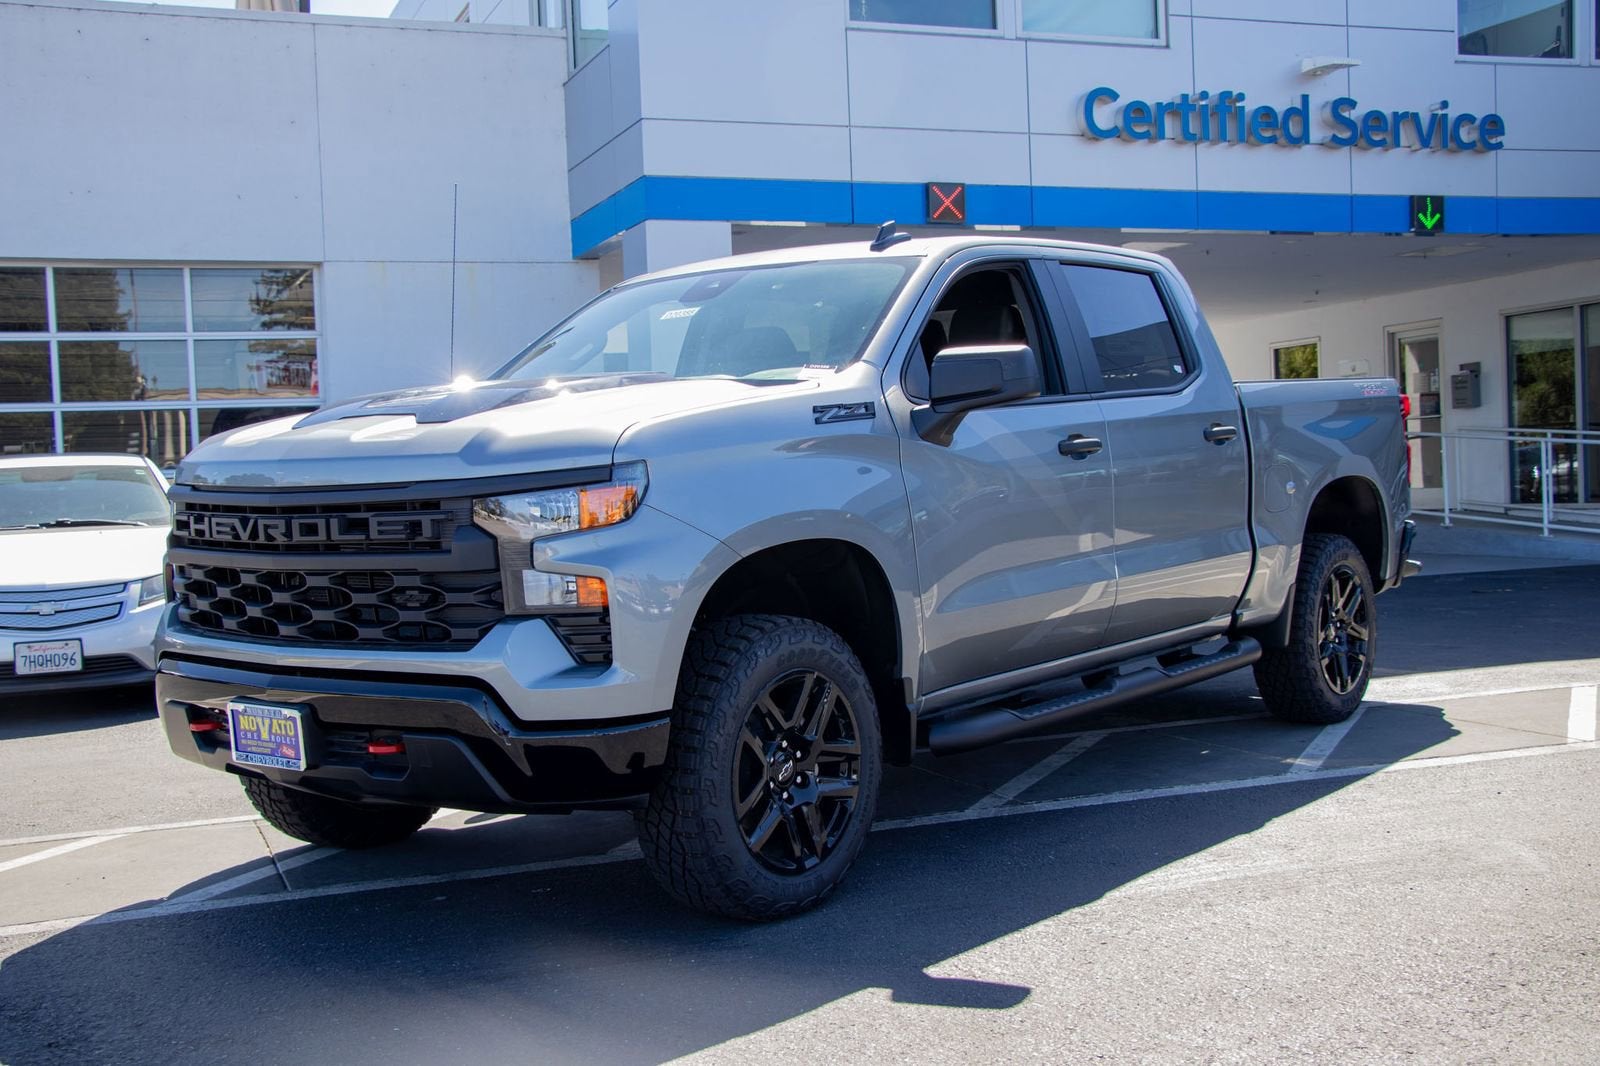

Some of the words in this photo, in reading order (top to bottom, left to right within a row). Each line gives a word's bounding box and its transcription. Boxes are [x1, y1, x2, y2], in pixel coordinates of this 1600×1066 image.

[1084, 87, 1311, 145] Certified
[1330, 97, 1506, 151] Service
[813, 401, 876, 425] Z71
[172, 511, 452, 543] CHEVROLET
[20, 652, 77, 669] 7HQH096
[239, 715, 294, 739] NOVATO
